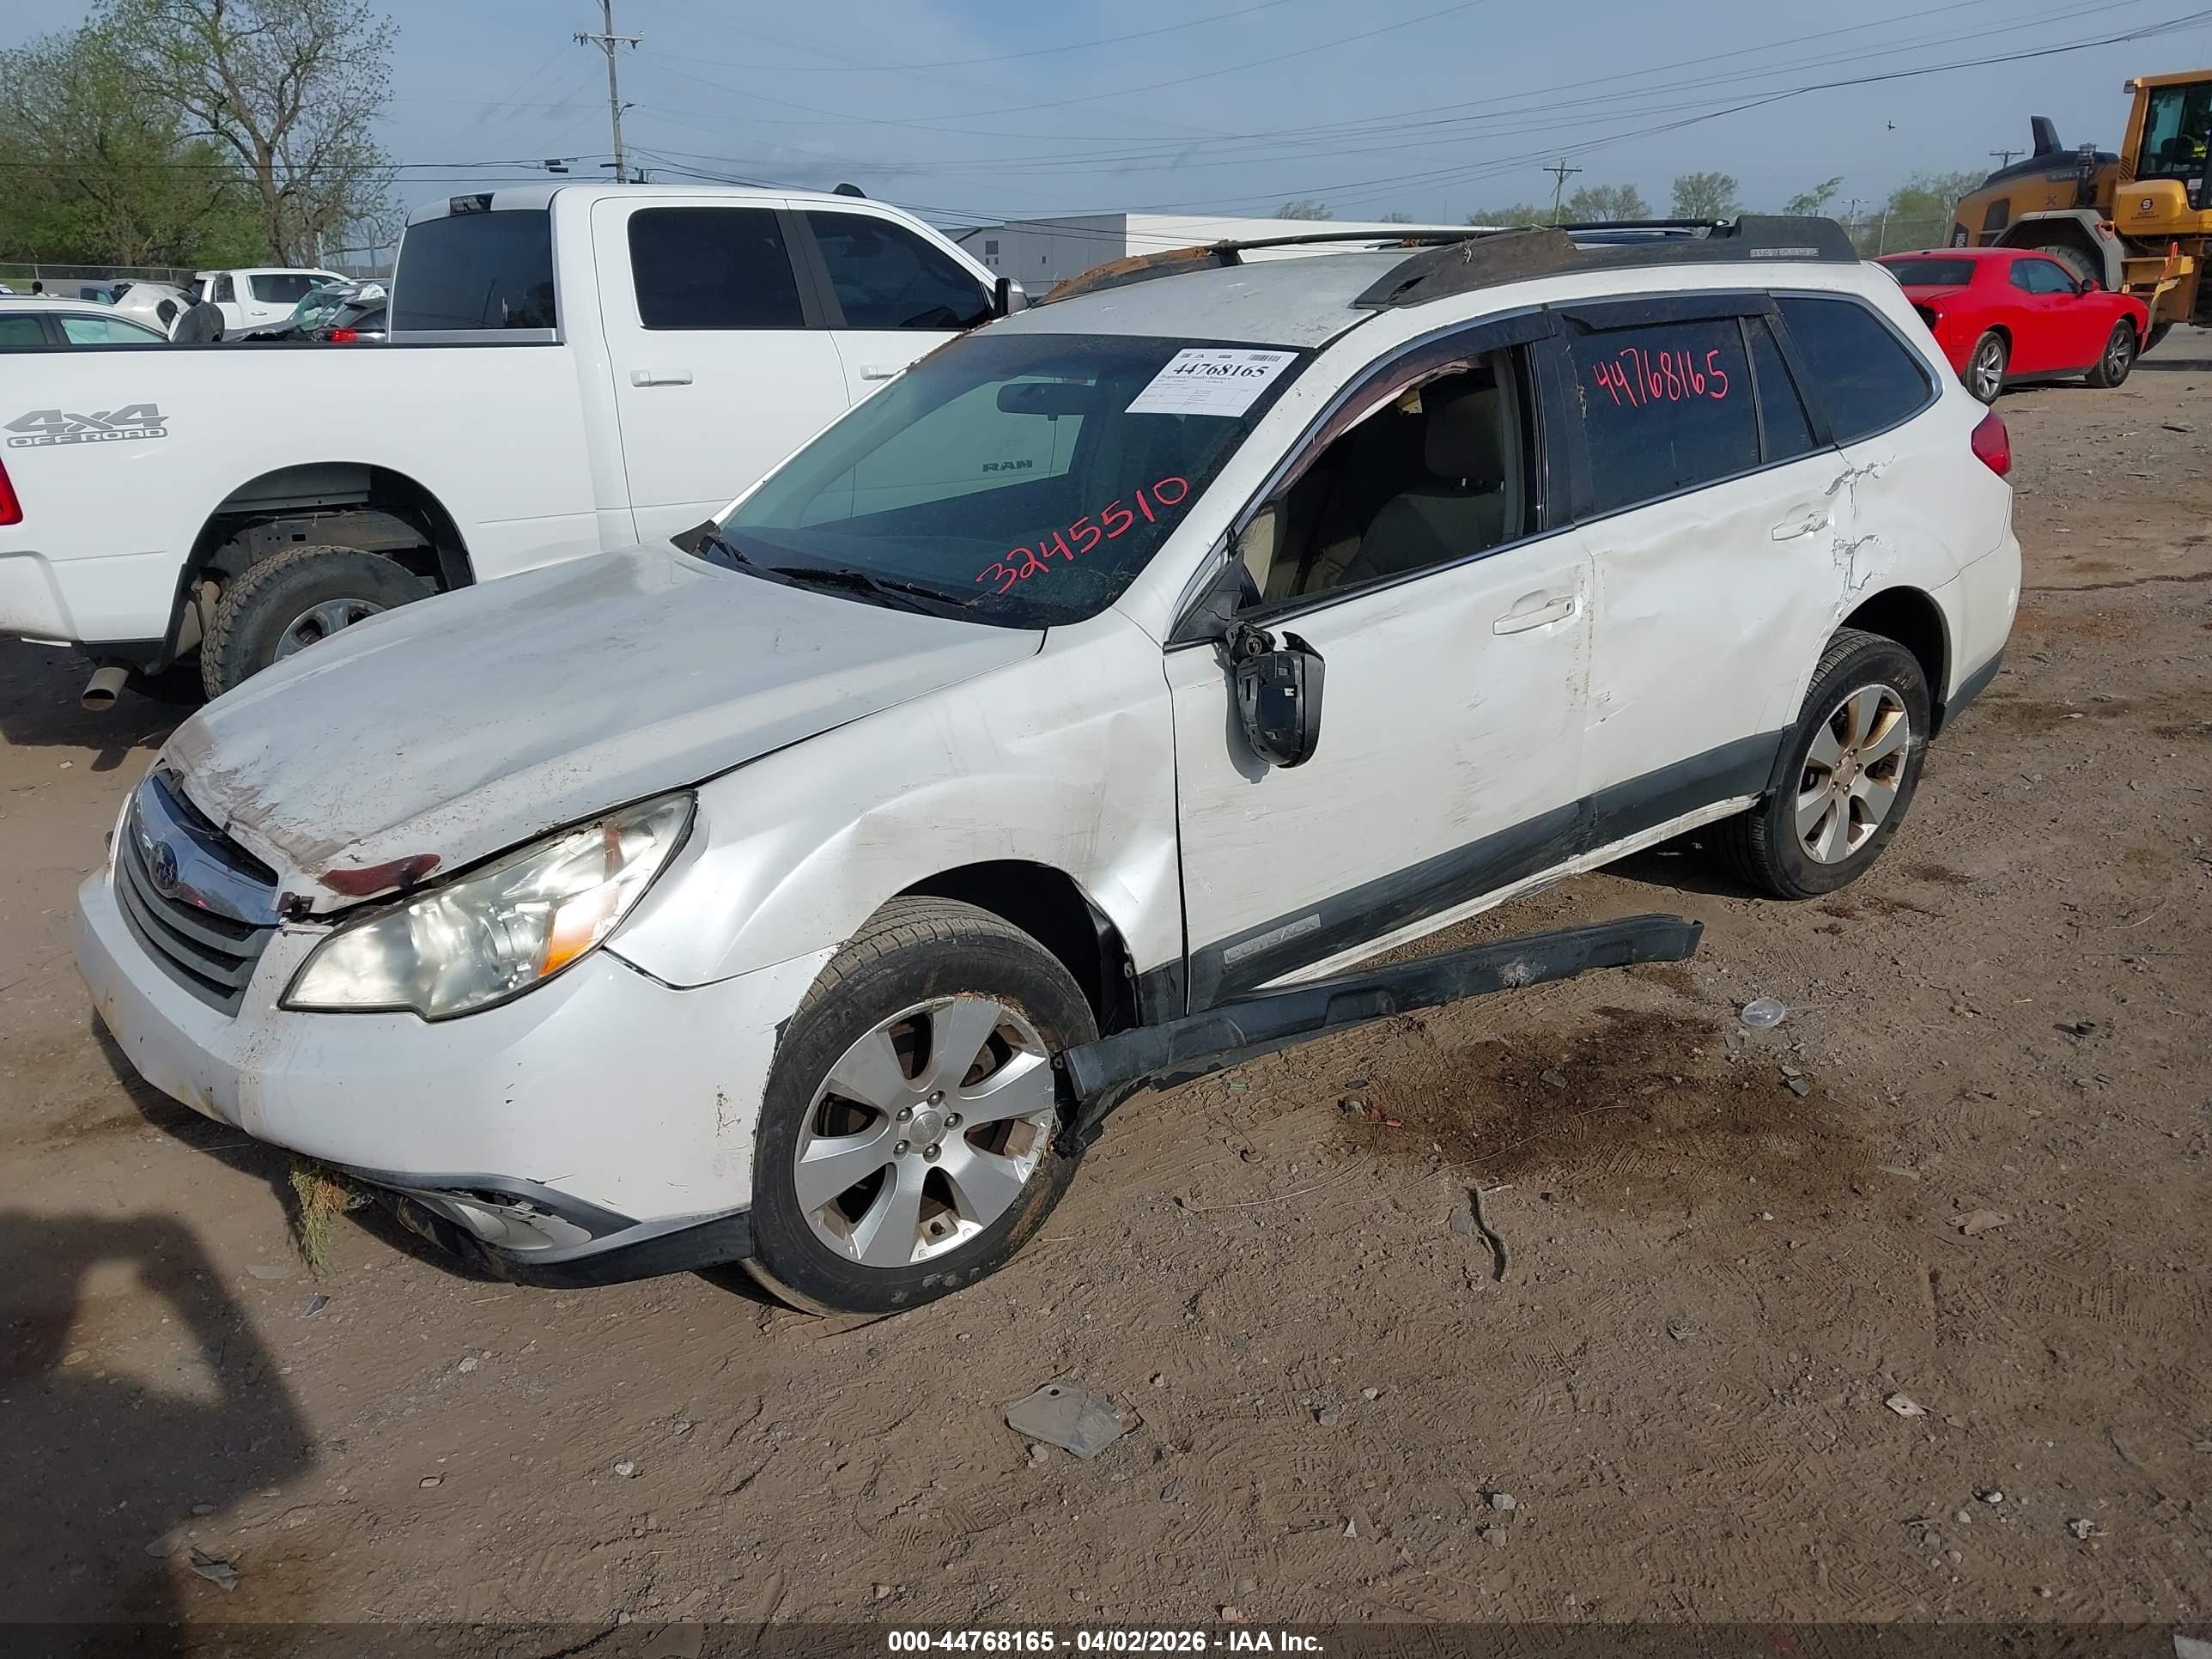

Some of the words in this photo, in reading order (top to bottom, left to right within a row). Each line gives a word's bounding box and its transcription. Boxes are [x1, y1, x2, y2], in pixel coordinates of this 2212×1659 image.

[1173, 362, 1270, 378] 44768165
[1593, 348, 1729, 408] 44768165
[10, 434, 72, 447] OFF
[80, 428, 166, 442] ROAD
[981, 459, 1033, 472] RAM
[975, 476, 1189, 595] 3245510
[1226, 919, 1316, 961] OUTBACK
